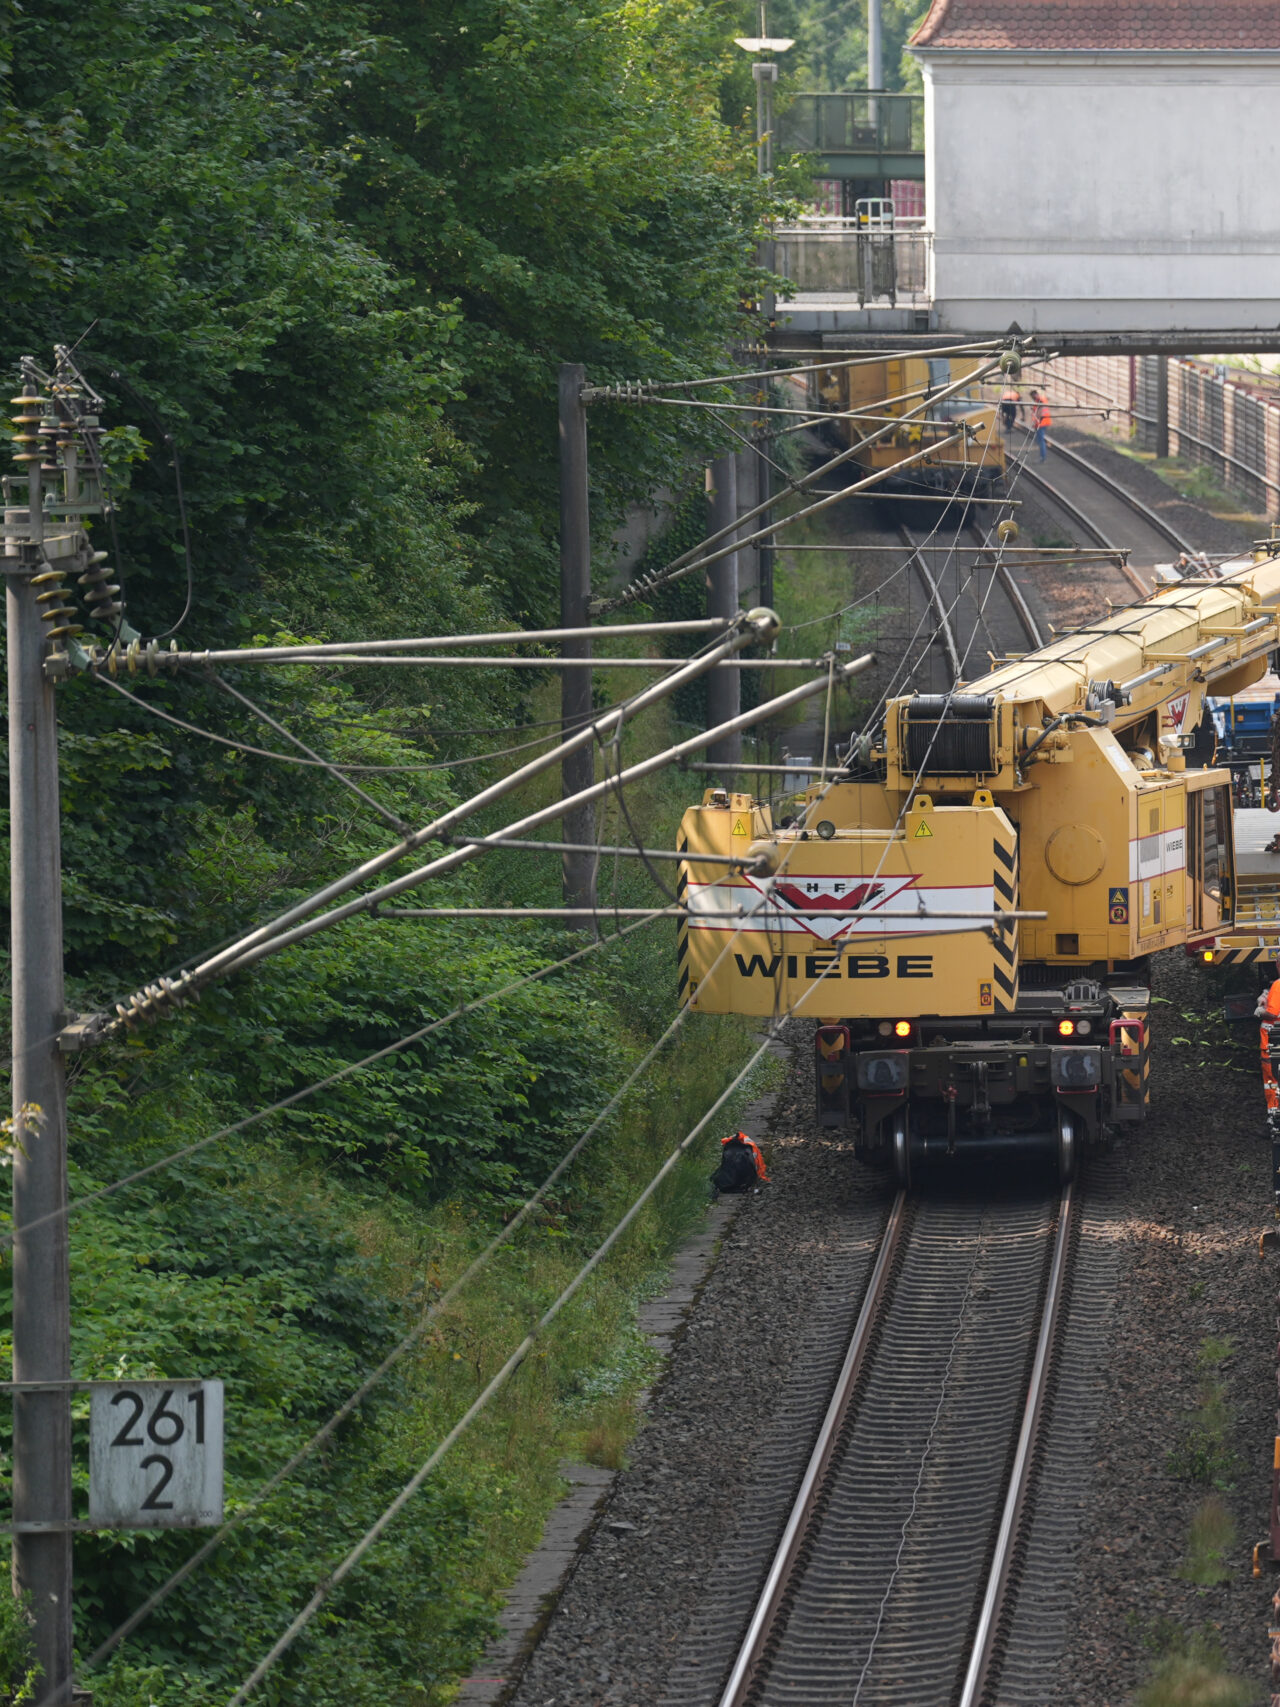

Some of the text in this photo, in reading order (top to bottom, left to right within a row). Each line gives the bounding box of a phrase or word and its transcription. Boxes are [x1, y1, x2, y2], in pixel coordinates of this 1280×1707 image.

[1166, 839, 1183, 852] WIEBE
[734, 953, 934, 979] WIEBE
[110, 1390, 205, 1446] 261
[140, 1454, 174, 1510] 2
